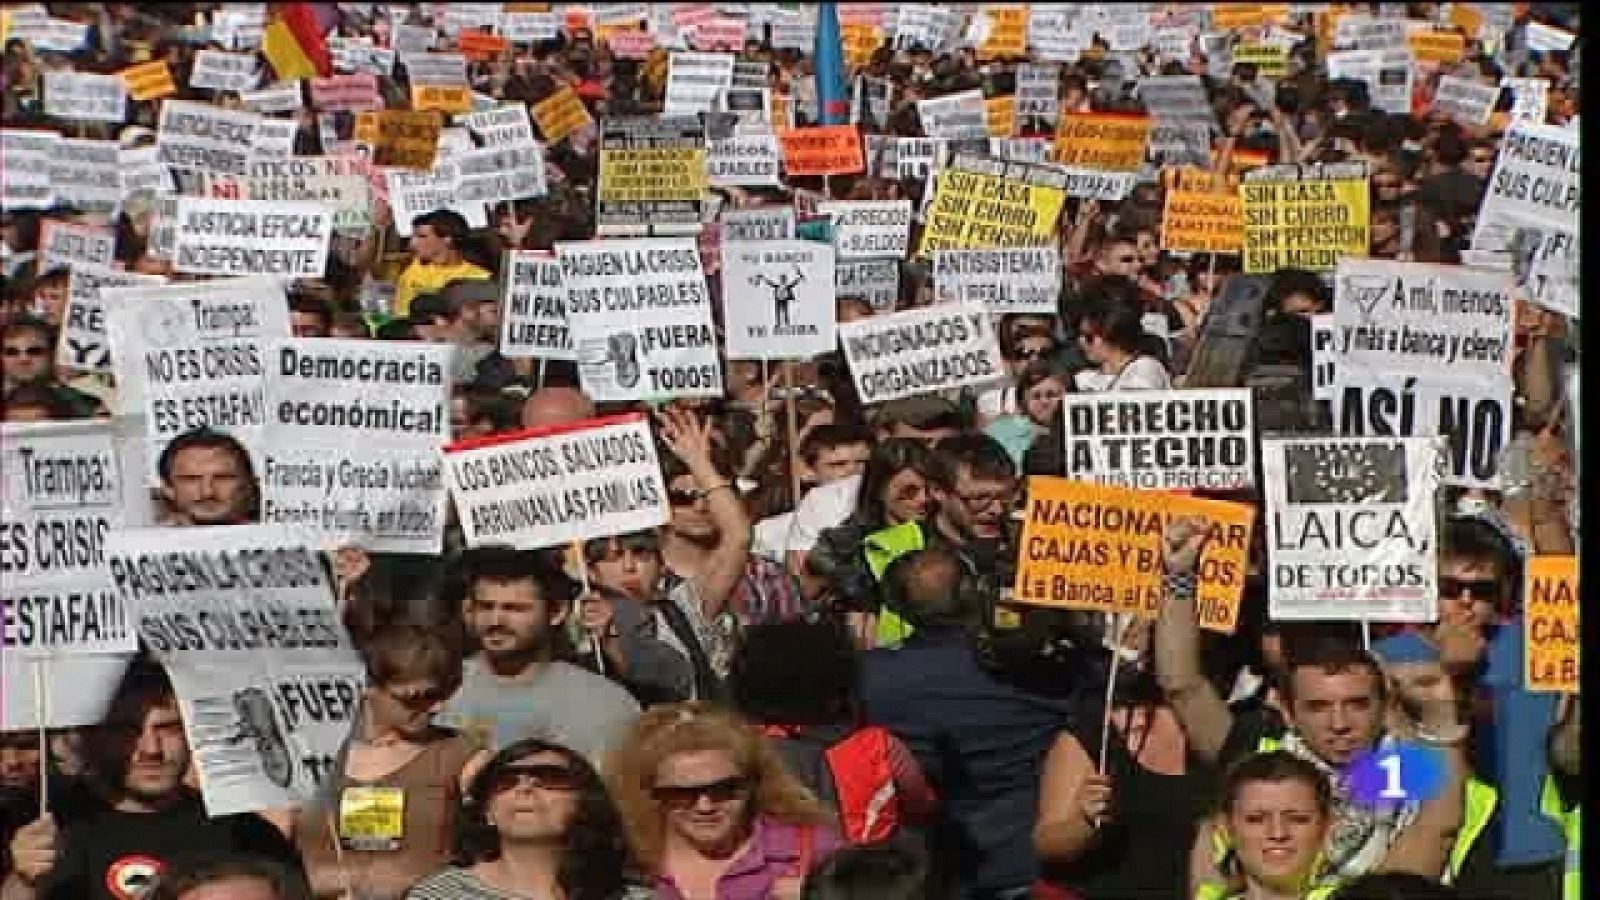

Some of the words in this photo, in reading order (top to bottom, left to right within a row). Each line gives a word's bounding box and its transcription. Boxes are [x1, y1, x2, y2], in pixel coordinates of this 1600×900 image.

[945, 173, 977, 192] SIN
[983, 178, 1031, 204] CASA
[1244, 183, 1276, 203] SIN
[1285, 183, 1336, 203] CASA
[1495, 168, 1530, 201] SUS
[937, 195, 970, 217] SIN
[1244, 205, 1277, 225] SIN
[1284, 204, 1348, 226] CURRO
[183, 211, 257, 238] JUSTICIA
[261, 214, 322, 239] EFICAZ
[1245, 228, 1278, 249] SIN
[560, 251, 624, 278] PAGUEN
[625, 250, 647, 276] LA
[648, 249, 698, 273] CRISIS
[1247, 251, 1278, 270] SIN
[567, 288, 601, 313] SUS
[1391, 278, 1405, 309] A
[190, 299, 261, 337] Trampa:
[848, 318, 967, 363] INDIGNADOS
[1341, 326, 1351, 355] y
[1388, 330, 1399, 351] a
[1401, 326, 1447, 356] banca
[1448, 334, 1460, 363] y
[146, 349, 173, 382] NO
[175, 346, 201, 381] ES
[280, 347, 442, 386] Democracia
[153, 397, 181, 432] ES
[278, 397, 442, 435] económica!
[1070, 400, 1247, 436] DERECHO
[1072, 440, 1092, 473] A
[1100, 437, 1246, 468] TECHO
[1439, 396, 1504, 480] NO
[19, 446, 111, 502] Trampa:
[265, 457, 322, 488] Francia
[325, 464, 335, 495] y
[338, 458, 389, 489] Grecia
[453, 459, 490, 491] LOS
[470, 493, 554, 538] ARRUINAN
[554, 489, 587, 524] LAS
[586, 475, 659, 519] FAMILIAS
[1274, 510, 1430, 555] LAICA,
[1028, 536, 1109, 567] CAJAS
[1117, 544, 1131, 568] Y
[109, 550, 210, 602] PAGUEN
[1021, 574, 1045, 598] La
[1124, 586, 1141, 604] al
[1276, 563, 1311, 588] DE
[138, 607, 206, 651] SUS
